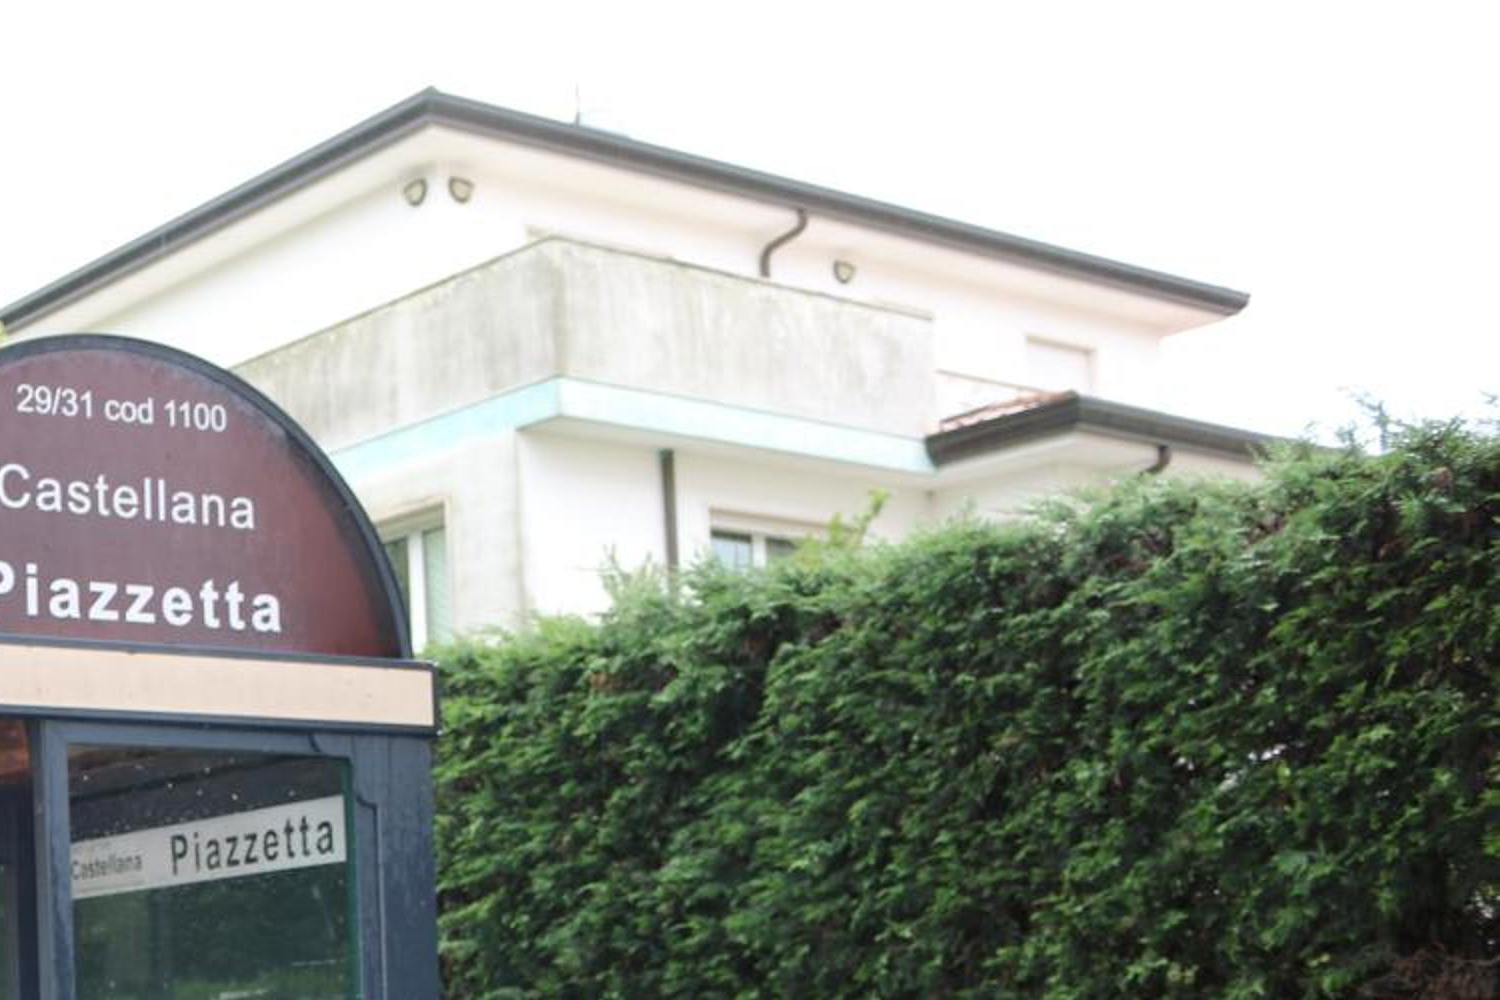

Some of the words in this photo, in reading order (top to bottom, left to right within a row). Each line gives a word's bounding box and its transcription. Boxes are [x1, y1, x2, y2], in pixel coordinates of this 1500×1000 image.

[16, 383, 93, 419] 29/31
[103, 398, 155, 425] cod
[163, 400, 228, 433] 1100
[70, 853, 143, 881] Castellana
[170, 815, 335, 876] Piazzetta
